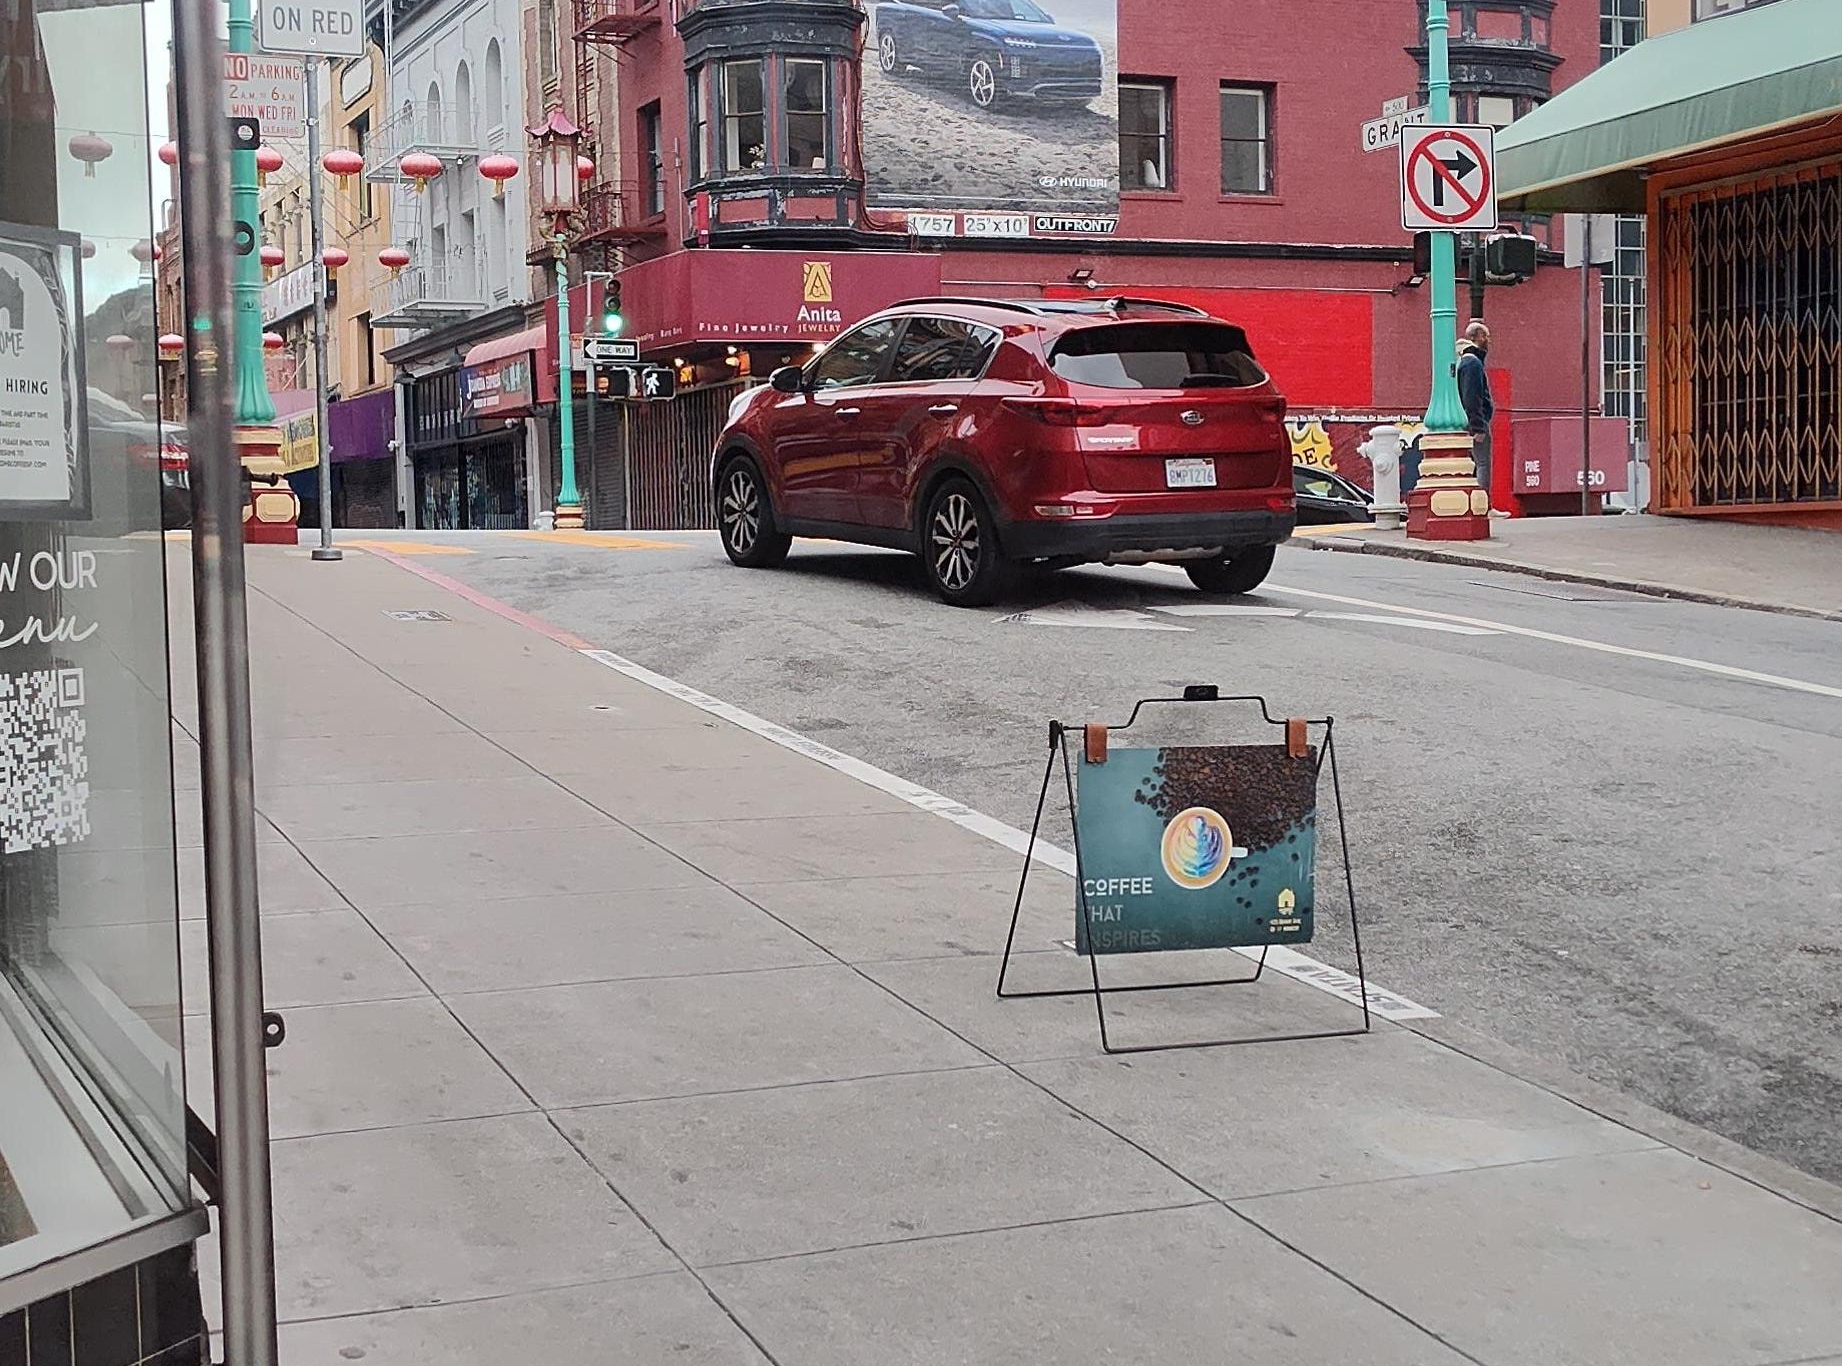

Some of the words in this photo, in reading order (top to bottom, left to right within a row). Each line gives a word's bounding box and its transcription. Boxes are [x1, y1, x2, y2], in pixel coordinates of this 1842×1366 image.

[273, 6, 301, 31] ON
[312, 9, 353, 35] RED
[224, 57, 246, 79] NO
[251, 64, 300, 81] PARKING
[230, 84, 239, 99] 2
[271, 86, 280, 101] 6
[231, 104, 254, 118] MON
[258, 105, 278, 121] WED
[281, 106, 296, 121] FRI
[1060, 178, 1107, 188] HYUNDAI
[797, 305, 842, 322] Anita
[699, 322, 729, 332] Fine
[735, 322, 789, 334] Jewelry
[798, 323, 841, 333] JEWELRY
[0, 330, 24, 357] ME
[596, 345, 613, 354] ONE
[615, 346, 633, 354] WAY
[6, 378, 49, 395] HIRING
[30, 551, 98, 591] OUR
[1084, 876, 1154, 897] COFFEE
